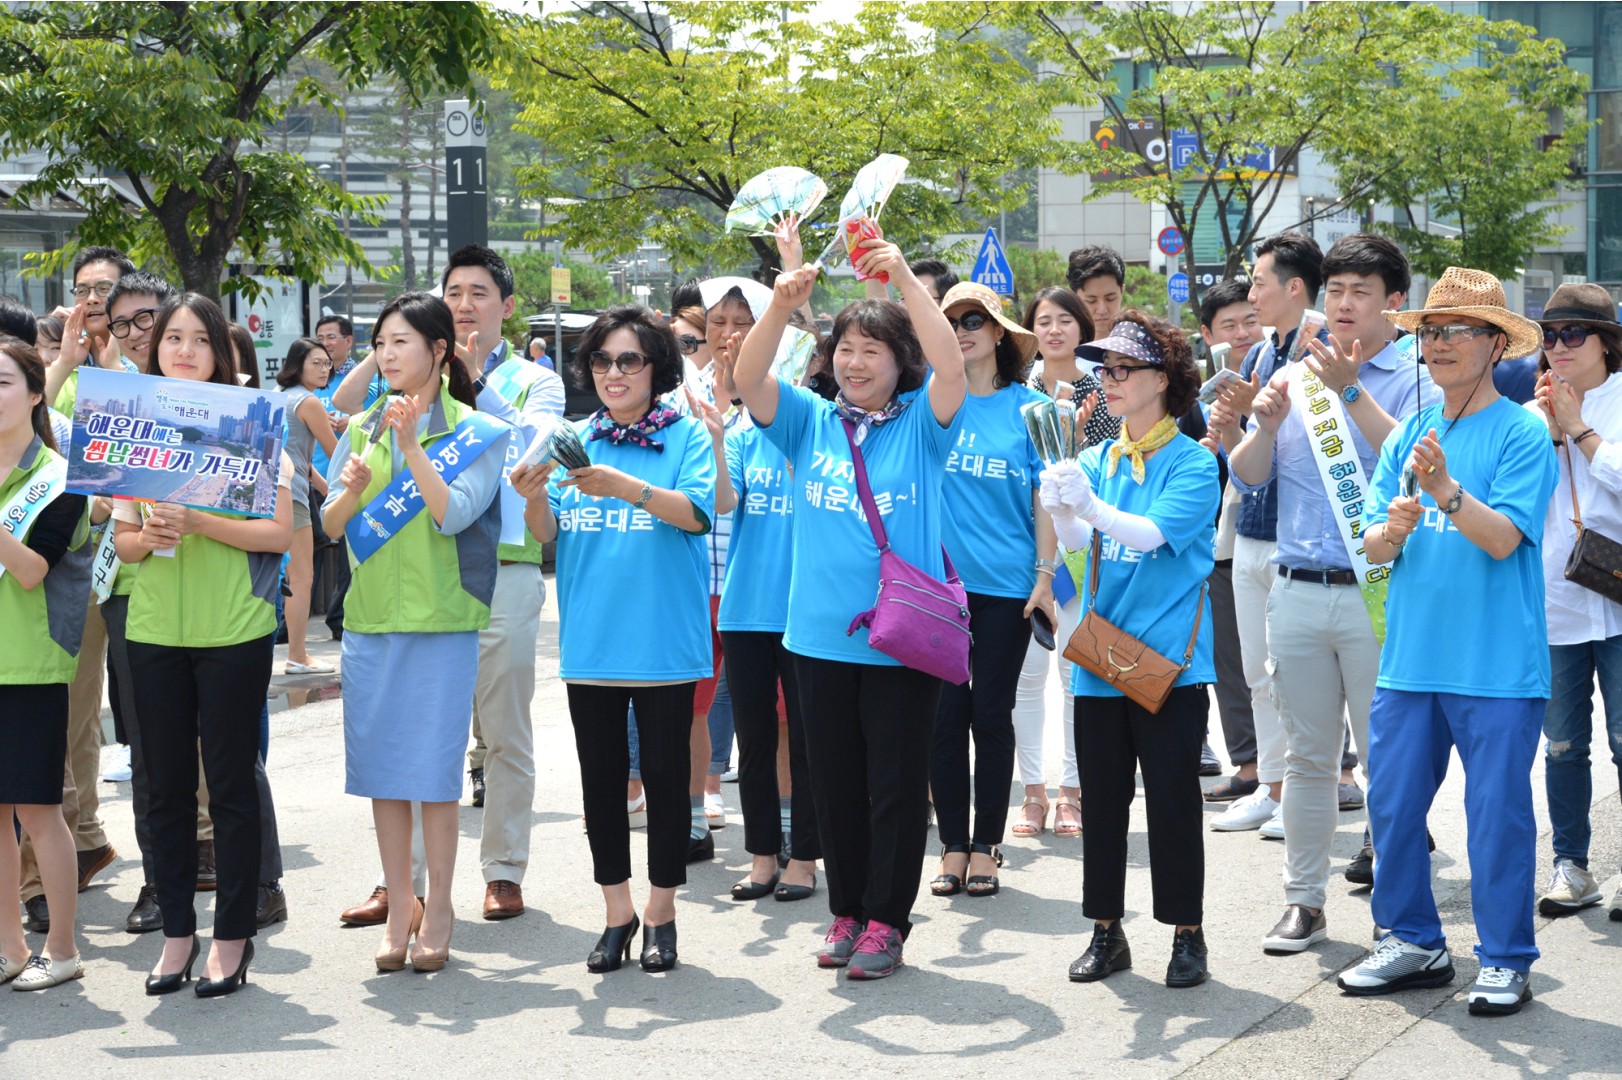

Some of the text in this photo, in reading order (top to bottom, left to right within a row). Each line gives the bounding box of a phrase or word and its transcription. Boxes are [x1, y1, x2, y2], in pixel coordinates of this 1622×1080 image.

[174, 406, 210, 420] 해운대
[87, 414, 182, 443] 해운대에는
[1314, 417, 1344, 458] 지금
[85, 440, 262, 482] 썸남썸녀가 가득!!
[945, 450, 1027, 486] 운대로~!
[745, 493, 793, 517] 운대
[559, 507, 670, 533] 해운대로
